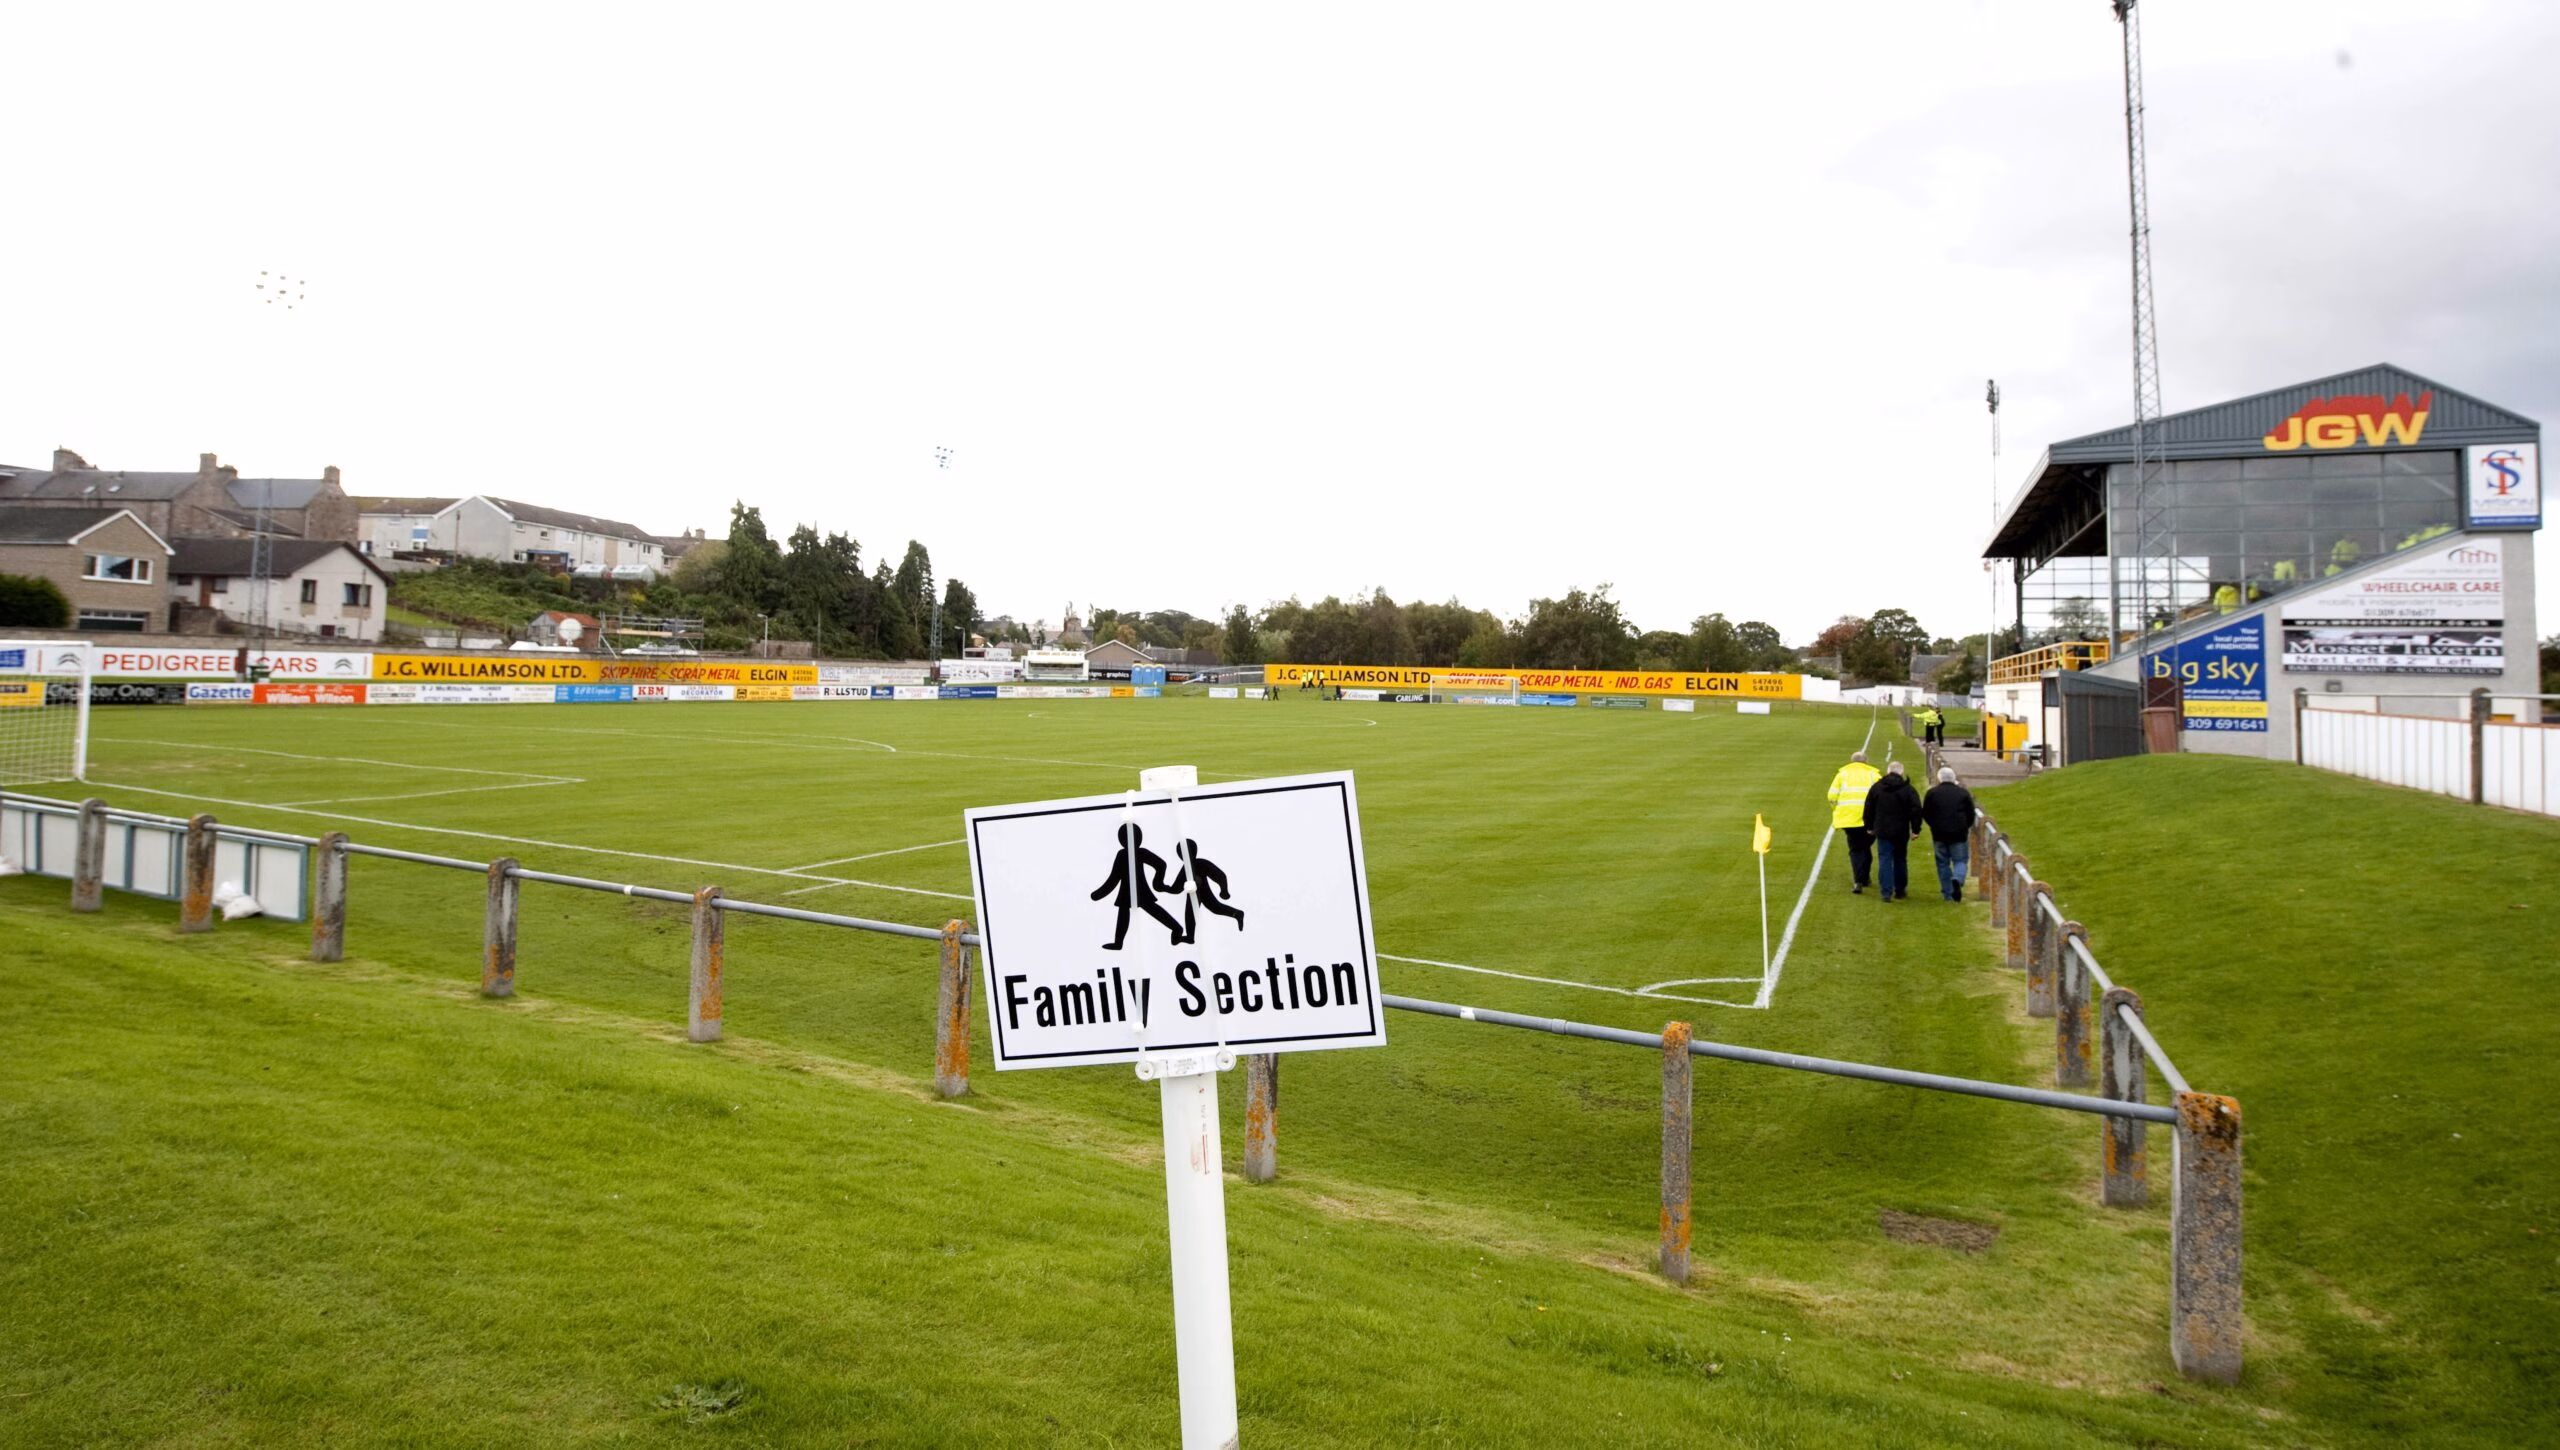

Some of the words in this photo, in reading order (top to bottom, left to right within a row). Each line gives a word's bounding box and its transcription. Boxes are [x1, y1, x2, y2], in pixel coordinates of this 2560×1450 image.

[2263, 405, 2430, 452] JGW
[2361, 582, 2458, 593] WHEELCHAIR
[2462, 581, 2502, 592] CARE
[2289, 641, 2389, 655] Mosset
[2401, 638, 2499, 656] Tavern
[2296, 655, 2337, 665] Next
[2344, 655, 2378, 665] Left
[2386, 655, 2399, 665] &
[383, 661, 418, 677] J.G.
[421, 662, 546, 679] WILLIAMSON
[551, 665, 588, 679] LTD.
[601, 666, 631, 680] SKIP
[631, 666, 659, 680] HIRE
[669, 667, 707, 681] SCRAP
[708, 668, 741, 681] METAL
[750, 669, 788, 681] ELGIN
[1277, 669, 1300, 681] J.G.
[1403, 671, 1436, 684] LTD.
[2154, 655, 2200, 686] bg
[2206, 655, 2259, 686] sky
[1477, 673, 1507, 686] HIRE
[1519, 674, 1560, 687] SCRAP
[1562, 675, 1604, 688] METAL
[1615, 677, 1641, 689] IND.
[1644, 677, 1673, 690] GAS
[1686, 678, 1739, 691] ELGIN
[47, 683, 116, 697] Chater
[118, 684, 157, 697] One
[190, 685, 253, 698] Gazette
[637, 686, 666, 697] KBM
[824, 686, 869, 697] ROLLSTUD
[266, 692, 311, 704] William
[314, 692, 355, 704] Wilson
[1396, 694, 1424, 703] CARLING
[1456, 696, 1516, 705] williamhill.com
[2215, 718, 2266, 730] 691641
[1004, 966, 1151, 1030] Family
[1174, 953, 1359, 1018] Section
